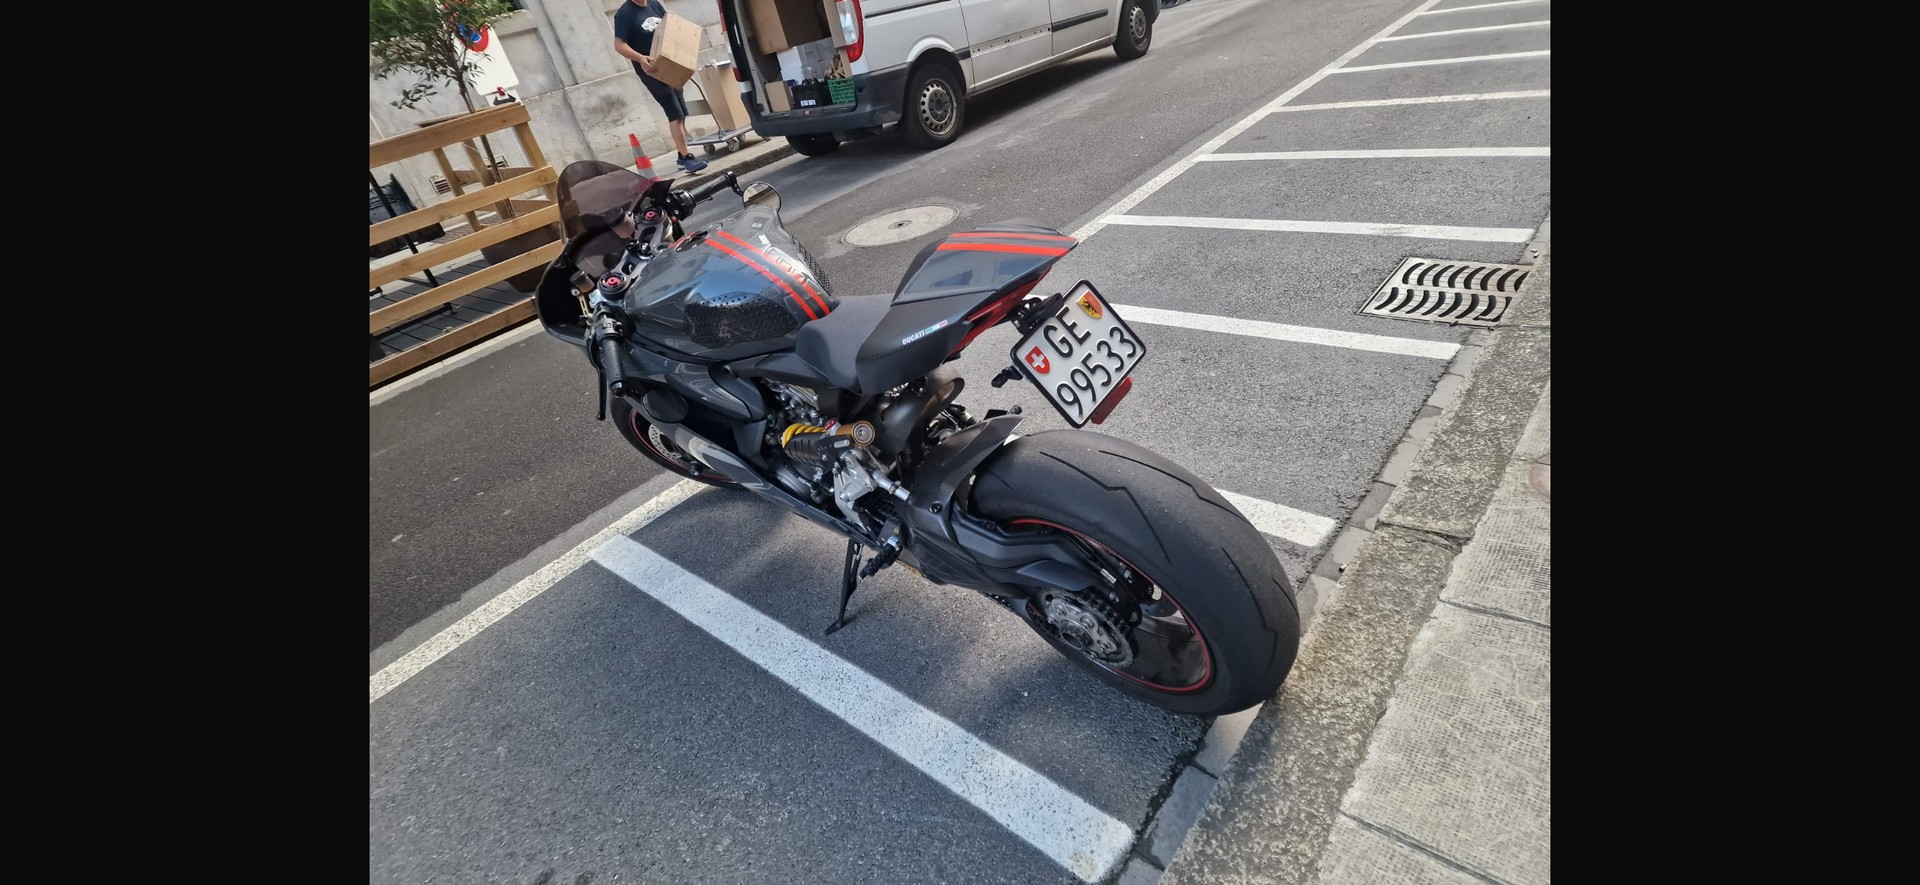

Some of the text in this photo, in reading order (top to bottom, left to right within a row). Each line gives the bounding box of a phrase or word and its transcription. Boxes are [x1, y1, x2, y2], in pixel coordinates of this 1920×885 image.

[902, 330, 925, 345] DUCATI
[1043, 306, 1091, 358] GE
[1056, 326, 1136, 417] 99533
